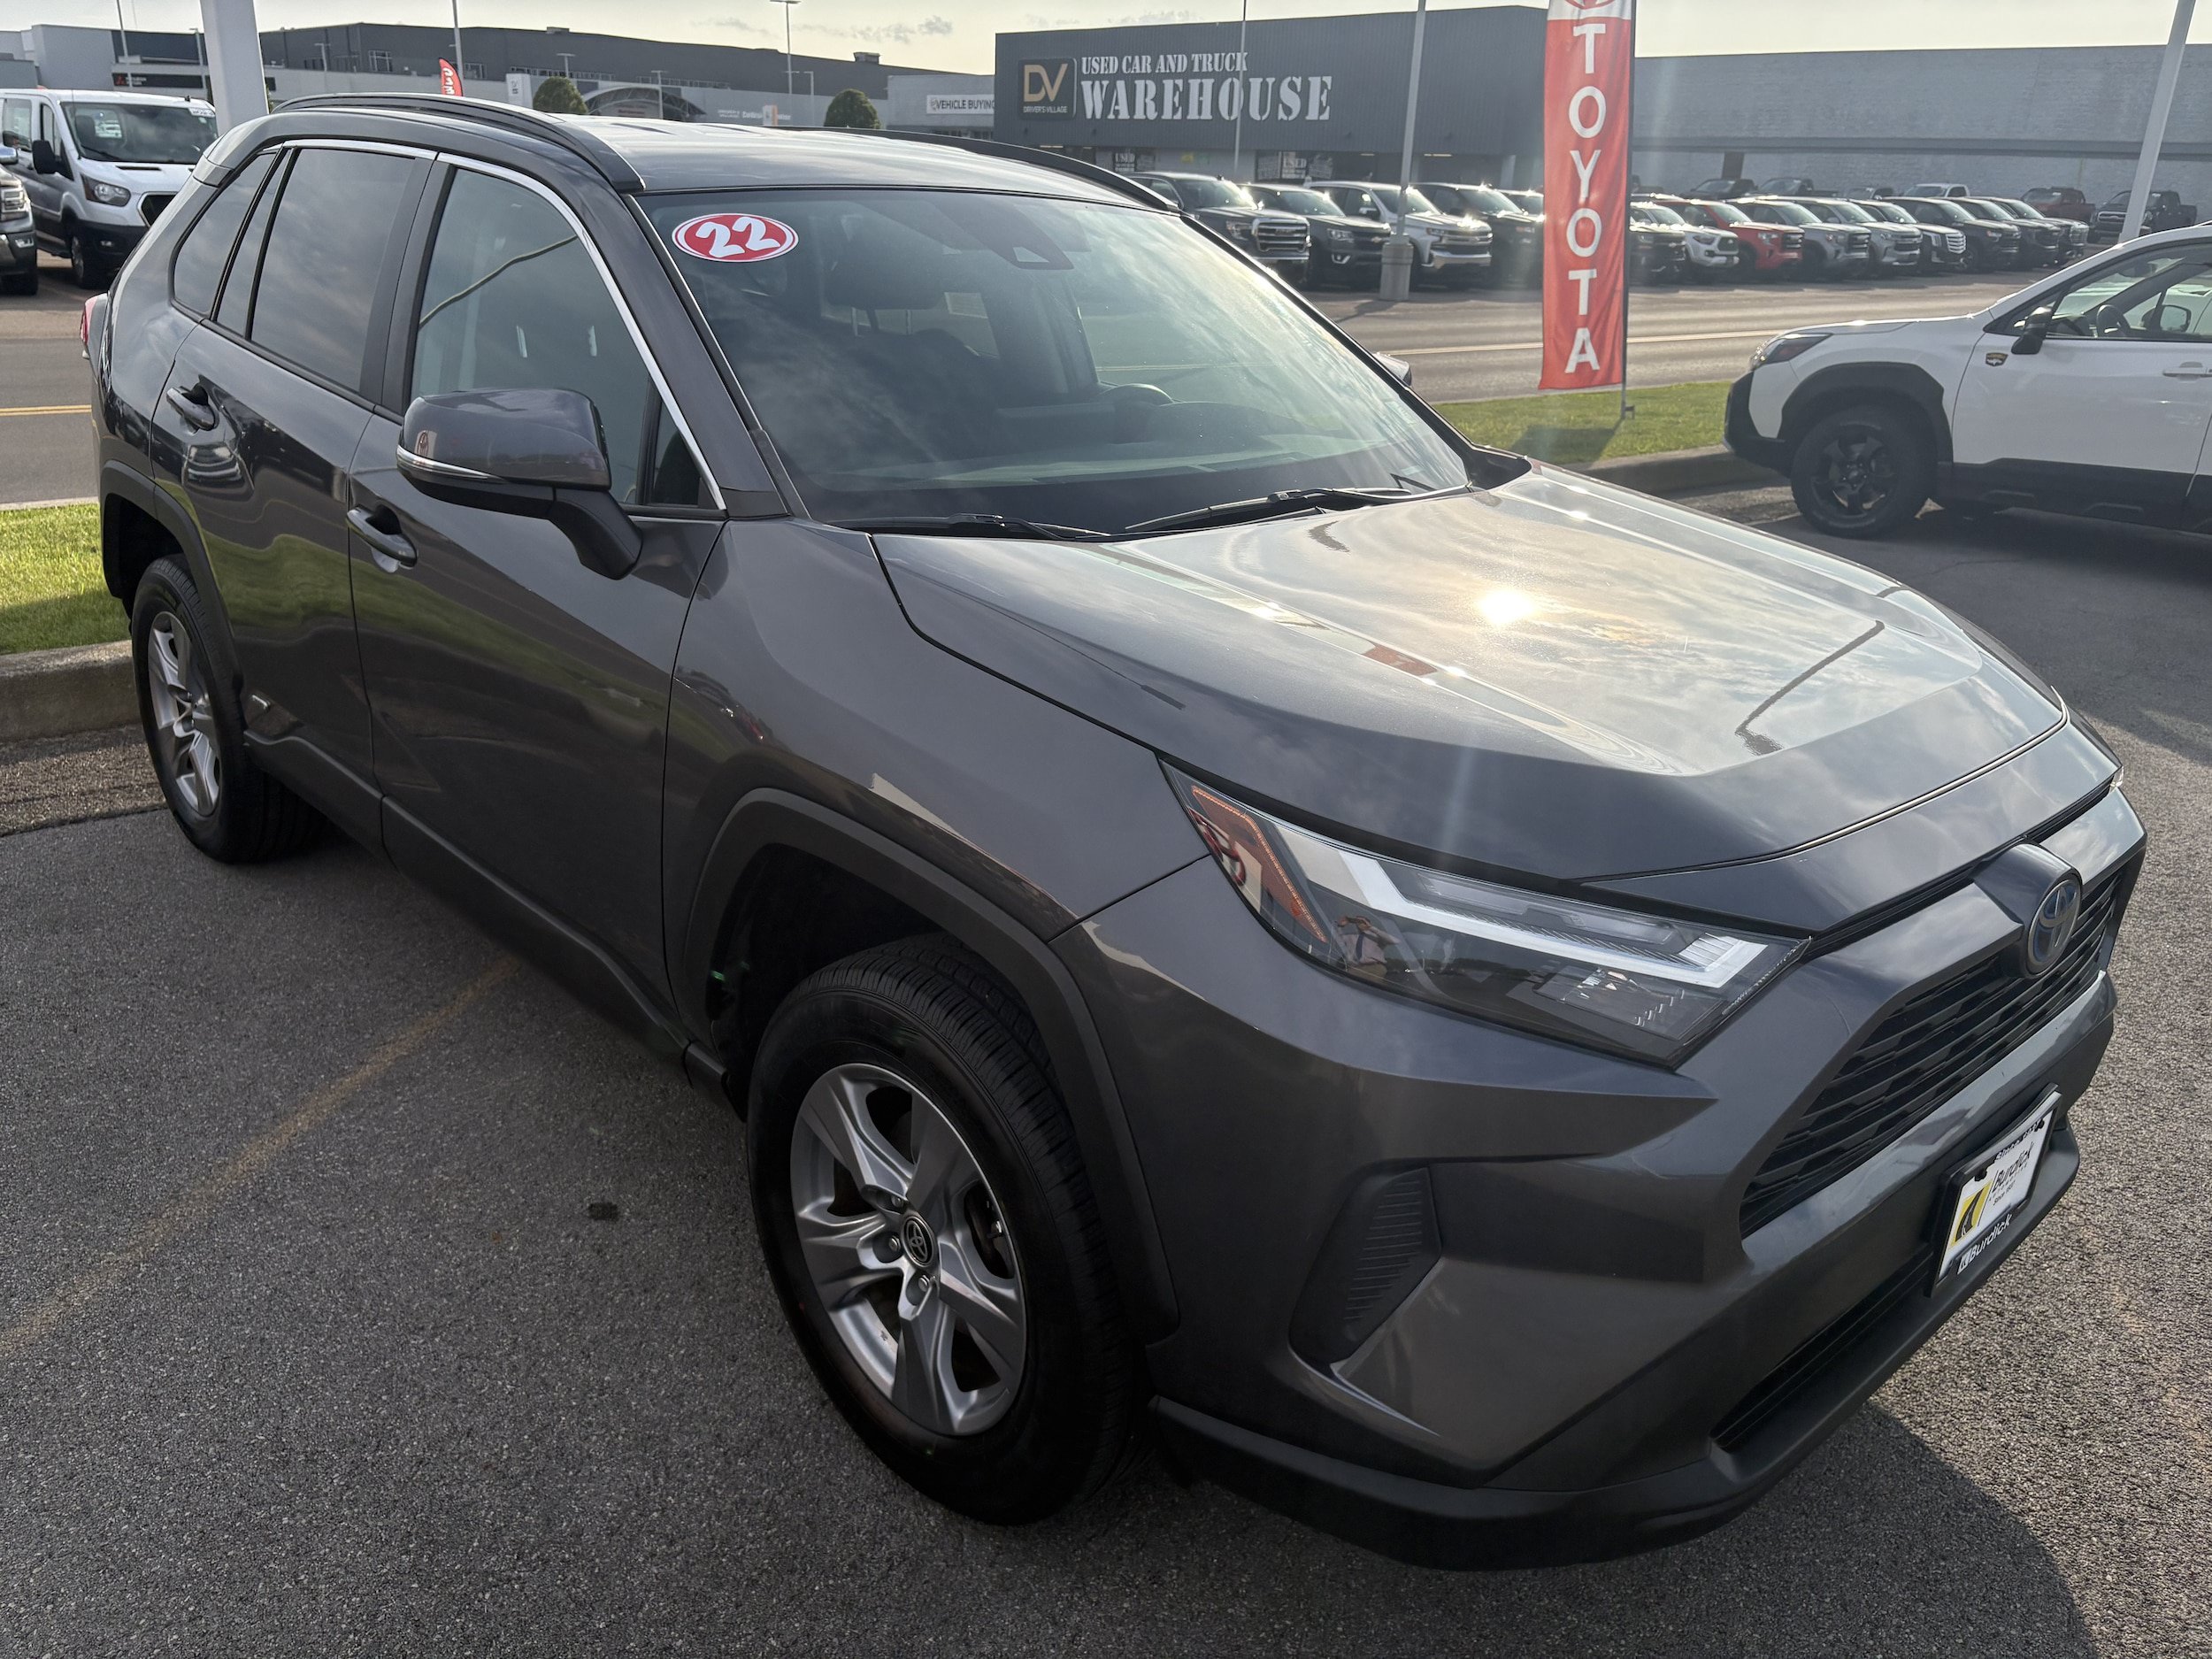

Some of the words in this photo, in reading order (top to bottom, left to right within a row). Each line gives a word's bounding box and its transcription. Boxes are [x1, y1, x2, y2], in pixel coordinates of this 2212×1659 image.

[1024, 63, 1068, 102] DV
[1081, 56, 1118, 74] USED
[1122, 55, 1152, 73] CAR
[1155, 54, 1188, 73] AND
[1191, 52, 1248, 73] TRUCK
[937, 99, 967, 110] VEHICLE
[1080, 76, 1333, 121] WAREHOUSE
[1564, 23, 1607, 374] TOYOTA
[695, 216, 781, 258] 22
[1991, 1141, 2035, 1193] Burdick
[1968, 1213, 2013, 1263] Burdick
